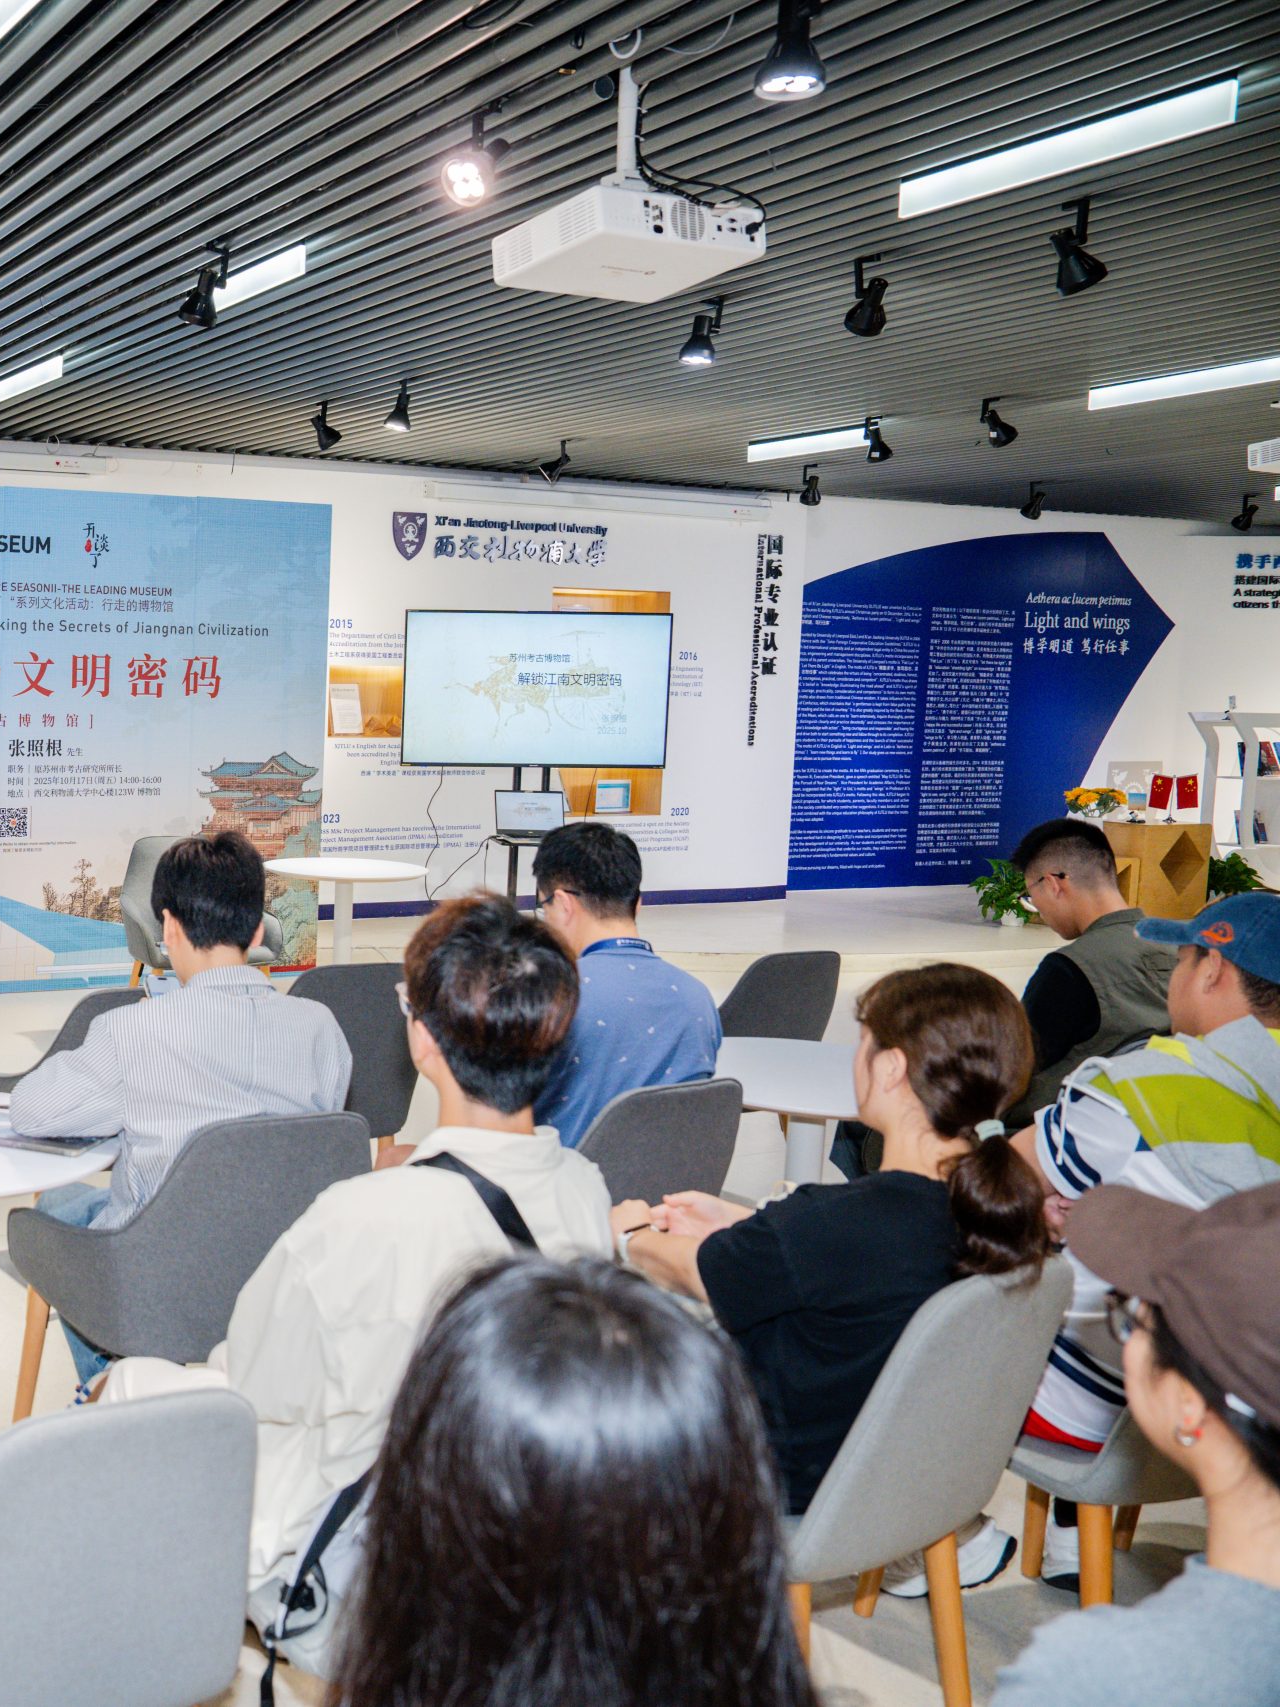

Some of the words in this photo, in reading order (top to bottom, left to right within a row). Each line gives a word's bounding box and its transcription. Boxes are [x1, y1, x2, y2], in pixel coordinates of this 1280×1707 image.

[559, 522, 608, 538] University
[754, 533, 767, 604] International
[83, 584, 128, 596] LEADING
[129, 586, 173, 597] MUSEUM
[1233, 588, 1242, 596] A
[1026, 592, 1061, 604] Aethera
[1072, 593, 1098, 605] lucem
[1098, 595, 1133, 608] petimus
[32, 619, 55, 632] the
[59, 619, 111, 633] Secrets
[116, 621, 129, 634] of
[133, 621, 194, 638] Jiangnan
[198, 622, 269, 637] Civilization
[329, 619, 353, 629] 2015
[1024, 611, 1060, 634] Light
[1064, 611, 1089, 629] and
[1093, 613, 1131, 636] wings
[750, 605, 763, 669] Professional
[509, 653, 571, 663] 苏州考古博物馆
[679, 652, 698, 661] 2016
[517, 672, 622, 687] 解锁江南文明密码
[747, 671, 760, 747] Accreditations
[8, 738, 63, 758] 张照根
[671, 808, 690, 816] 2020
